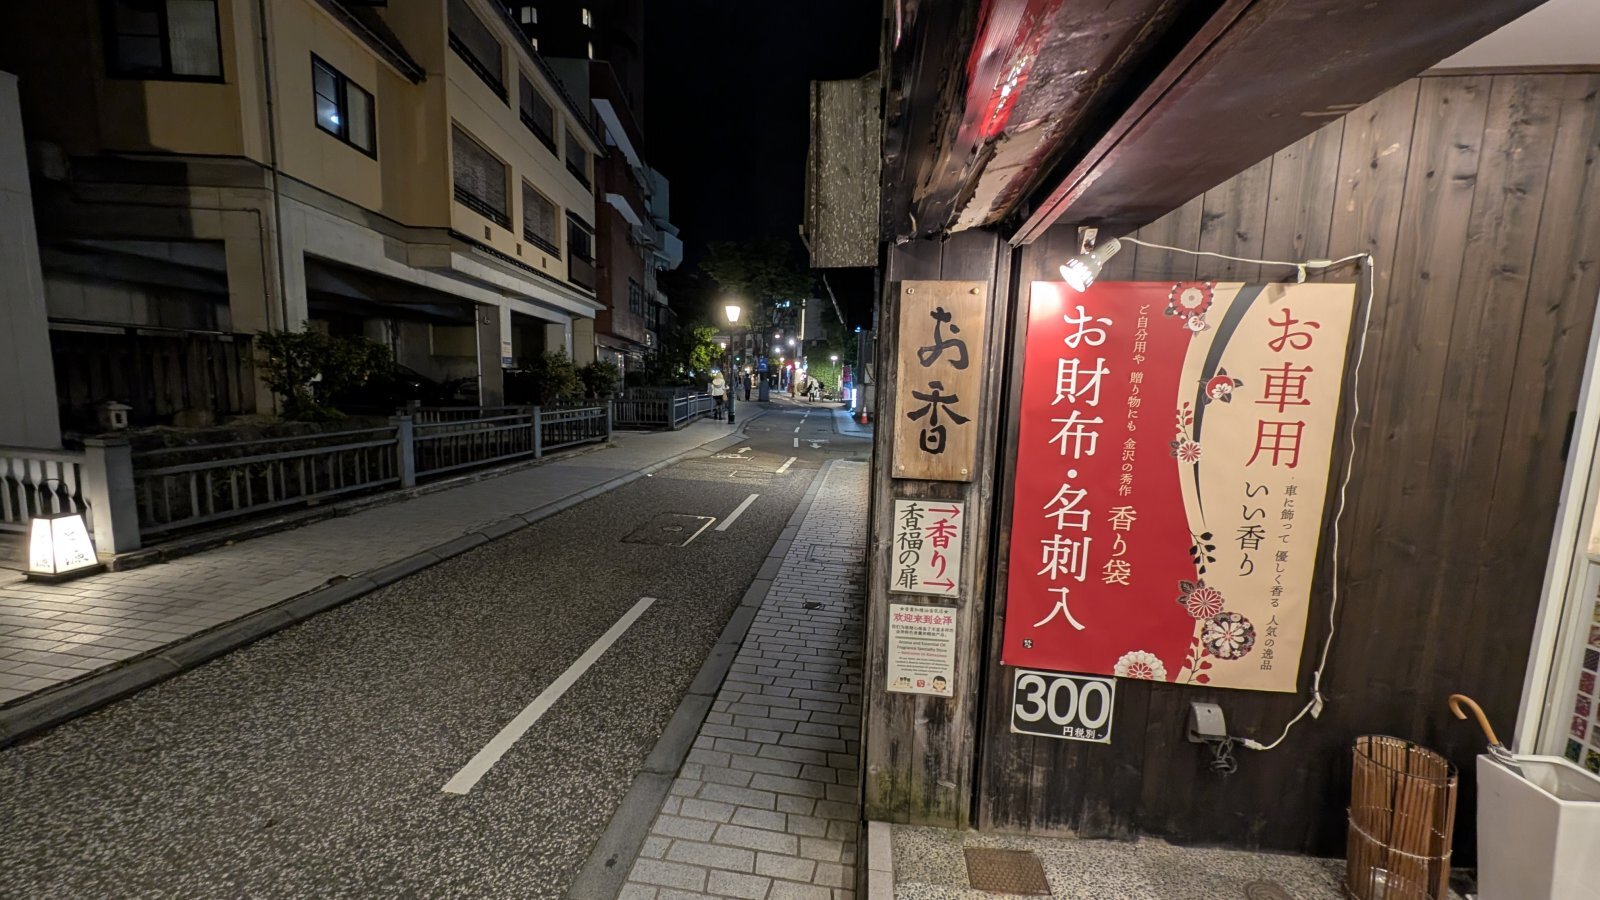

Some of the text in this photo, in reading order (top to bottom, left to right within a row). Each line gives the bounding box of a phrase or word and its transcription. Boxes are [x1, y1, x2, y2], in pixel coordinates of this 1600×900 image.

[906, 306, 971, 455] お香
[1102, 304, 1150, 586] ご自分用や 贈り物にも 金沢の秀作 香り袋
[1235, 307, 1321, 577] お車用 いい香り
[895, 502, 925, 589] 香福の扉
[924, 518, 958, 579] 香り
[1033, 305, 1113, 631] お財布・名刺入
[1260, 484, 1298, 671] 車に飾って 優しく香る 人気の逸品
[1015, 675, 1110, 729] 300
